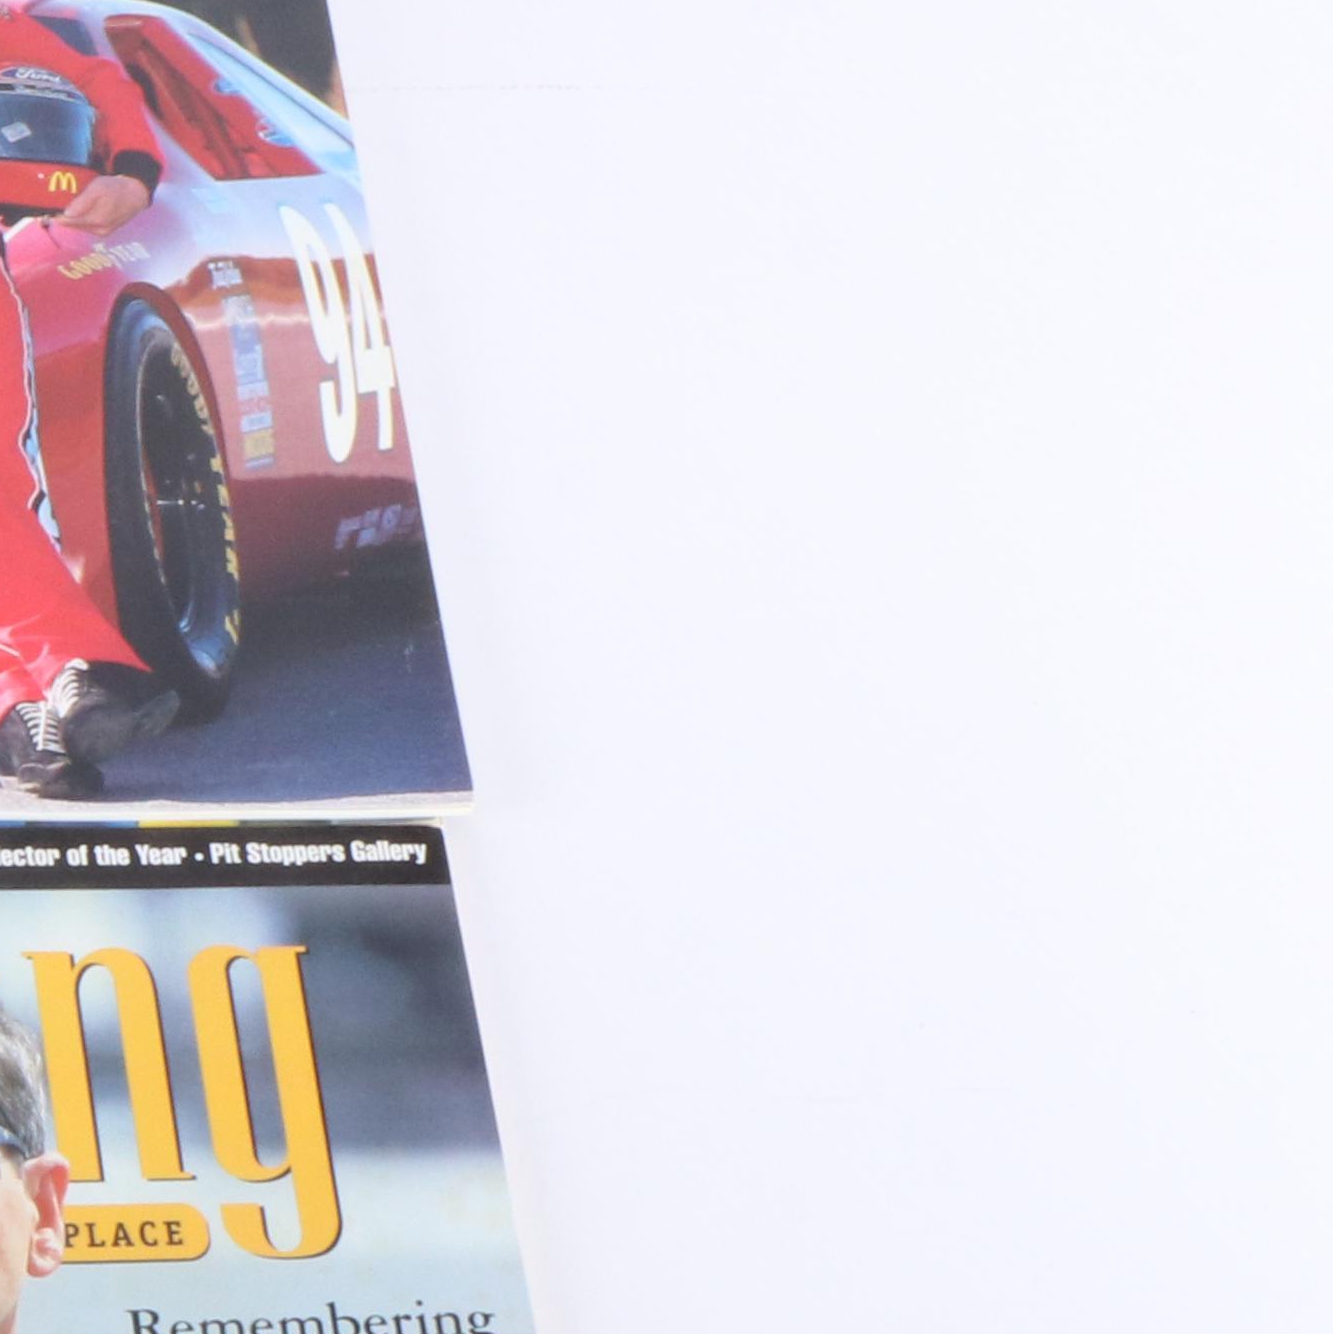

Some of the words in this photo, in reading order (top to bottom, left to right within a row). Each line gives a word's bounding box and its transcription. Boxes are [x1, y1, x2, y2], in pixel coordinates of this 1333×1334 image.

[279, 203, 395, 463] 94
[66, 845, 90, 866] of
[94, 845, 130, 866] the
[135, 844, 187, 865] Year
[209, 842, 242, 865] Pit
[247, 842, 346, 866] Stoppers
[350, 840, 427, 865] Gallery
